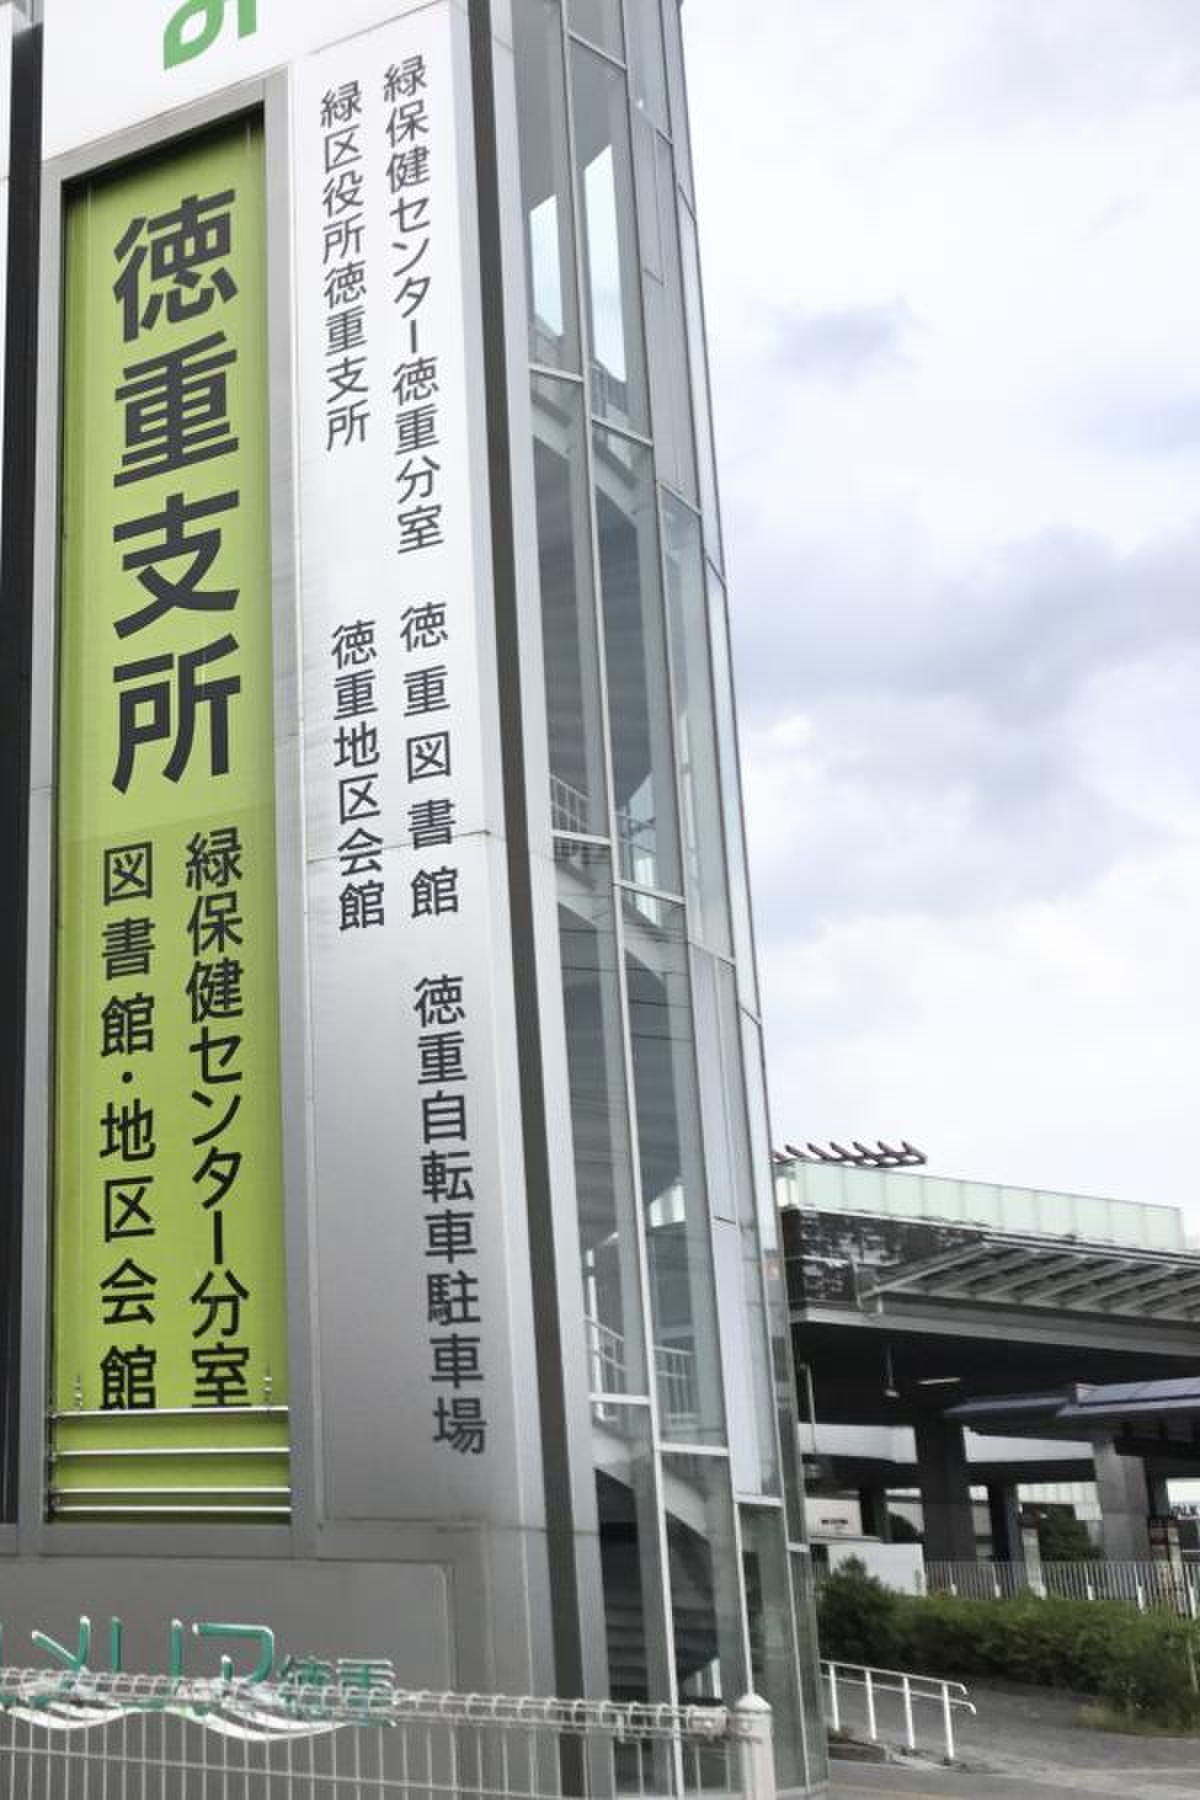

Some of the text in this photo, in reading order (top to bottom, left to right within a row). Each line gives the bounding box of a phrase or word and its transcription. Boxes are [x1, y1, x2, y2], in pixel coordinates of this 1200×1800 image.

[112, 188, 241, 795] 徳重支所
[320, 80, 385, 931] 緑区役所徳重支所 徳重地区会館
[384, 54, 487, 1455] 緑保健センター徳重分室 徳重図書館 徳重自転車駐車場
[185, 826, 250, 1409] 緑保健センター分室
